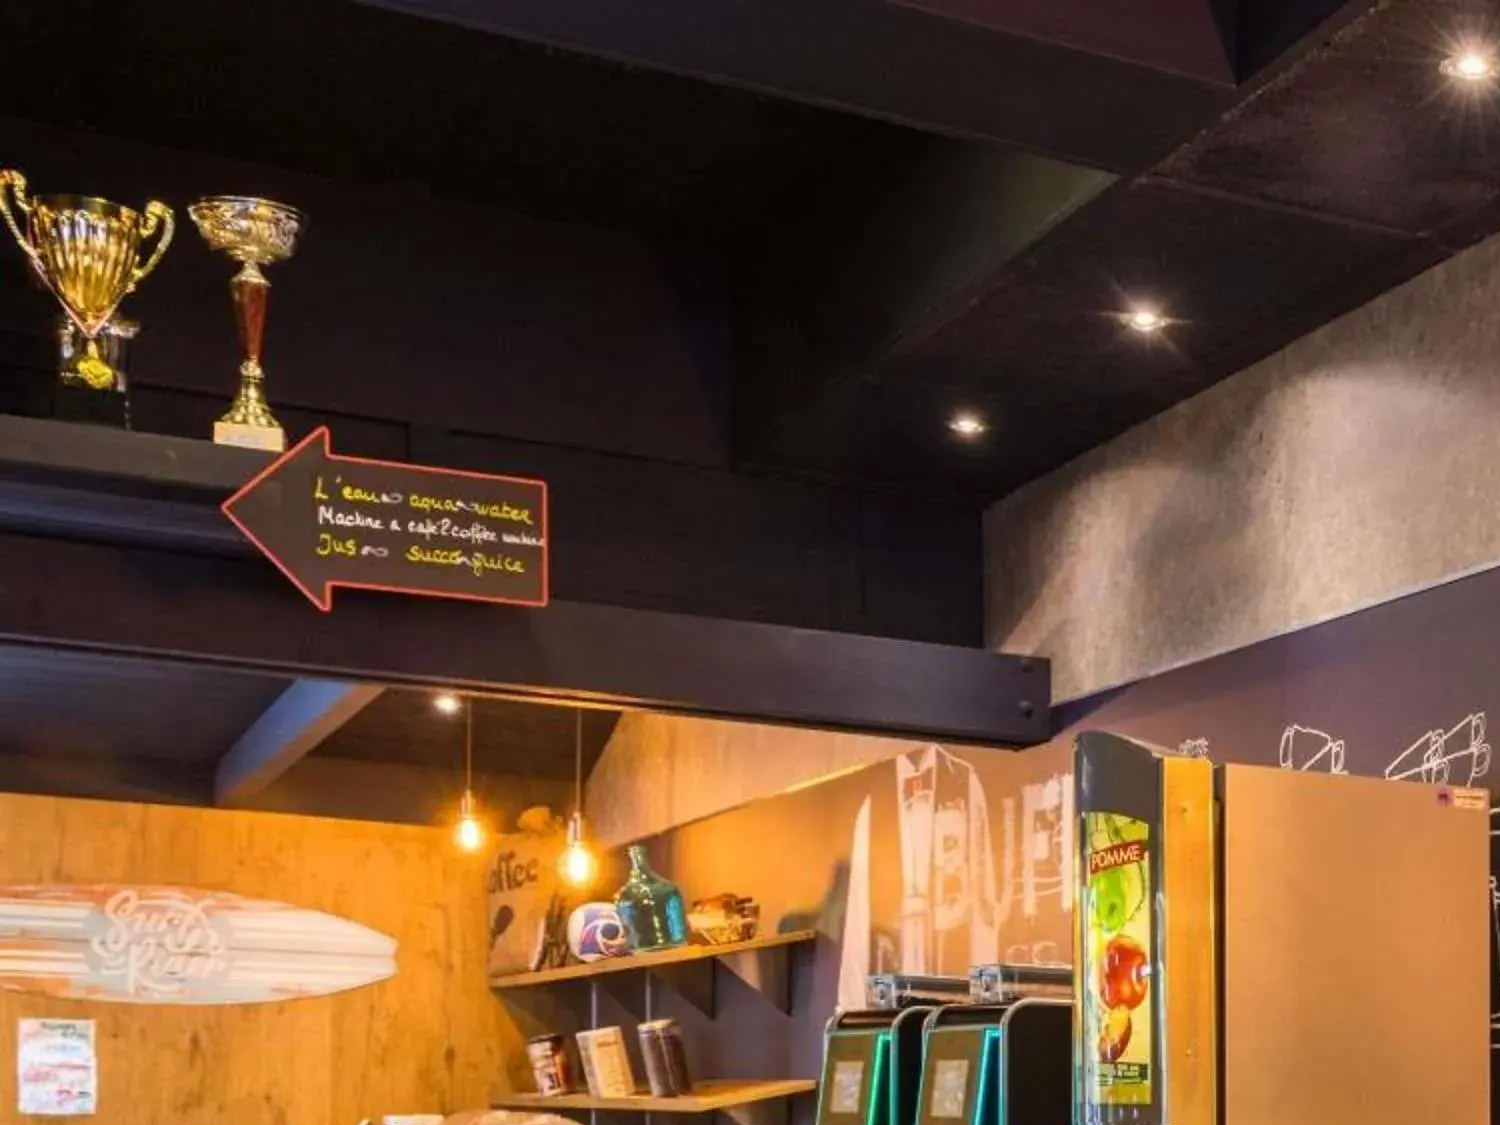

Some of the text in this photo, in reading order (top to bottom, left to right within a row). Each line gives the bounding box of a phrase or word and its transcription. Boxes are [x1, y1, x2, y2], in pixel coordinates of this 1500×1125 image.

[318, 504, 384, 530] Machine
[470, 502, 534, 525] water
[316, 533, 356, 557] Jus
[1091, 844, 1141, 872] POMME
